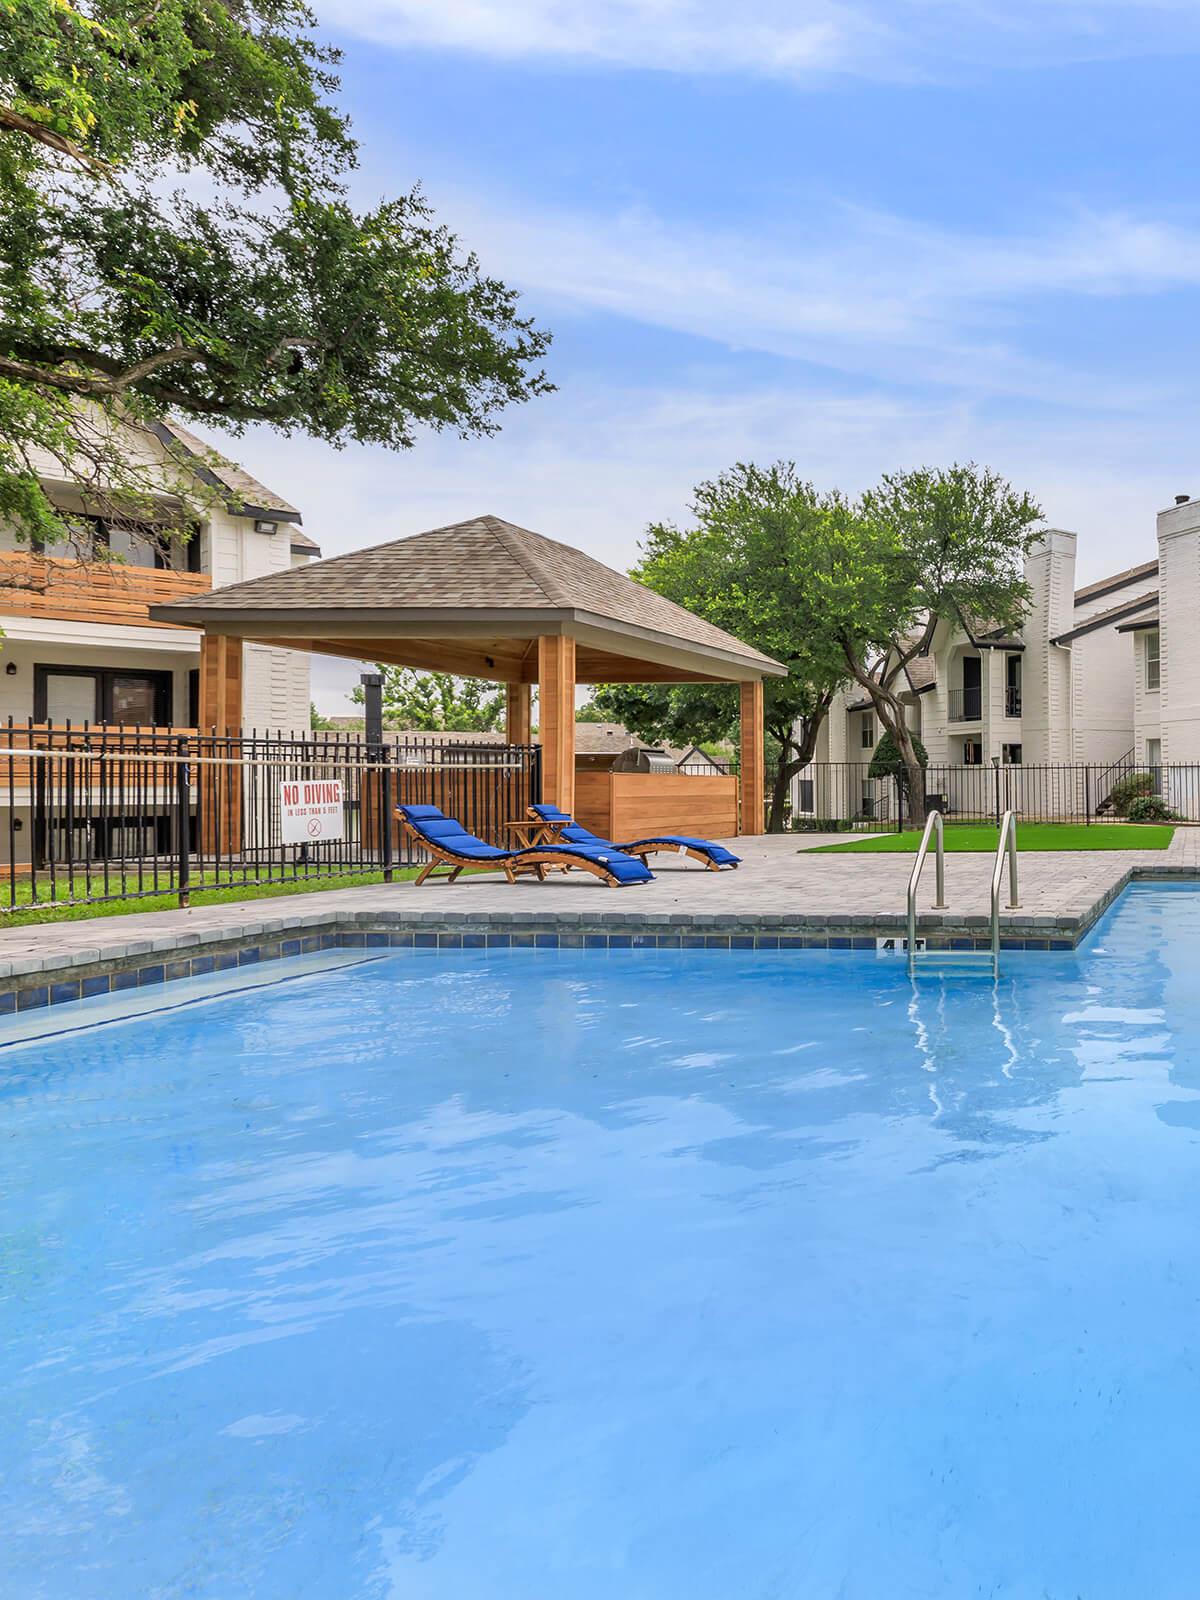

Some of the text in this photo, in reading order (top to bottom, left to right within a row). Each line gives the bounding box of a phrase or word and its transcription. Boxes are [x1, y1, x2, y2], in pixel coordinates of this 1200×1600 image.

[284, 784, 340, 806] NO DIVING
[288, 808, 293, 816] IN
[295, 808, 306, 816] LESS
[309, 807, 321, 815] THAN
[328, 806, 338, 814] FEET
[882, 939, 895, 950] 4
